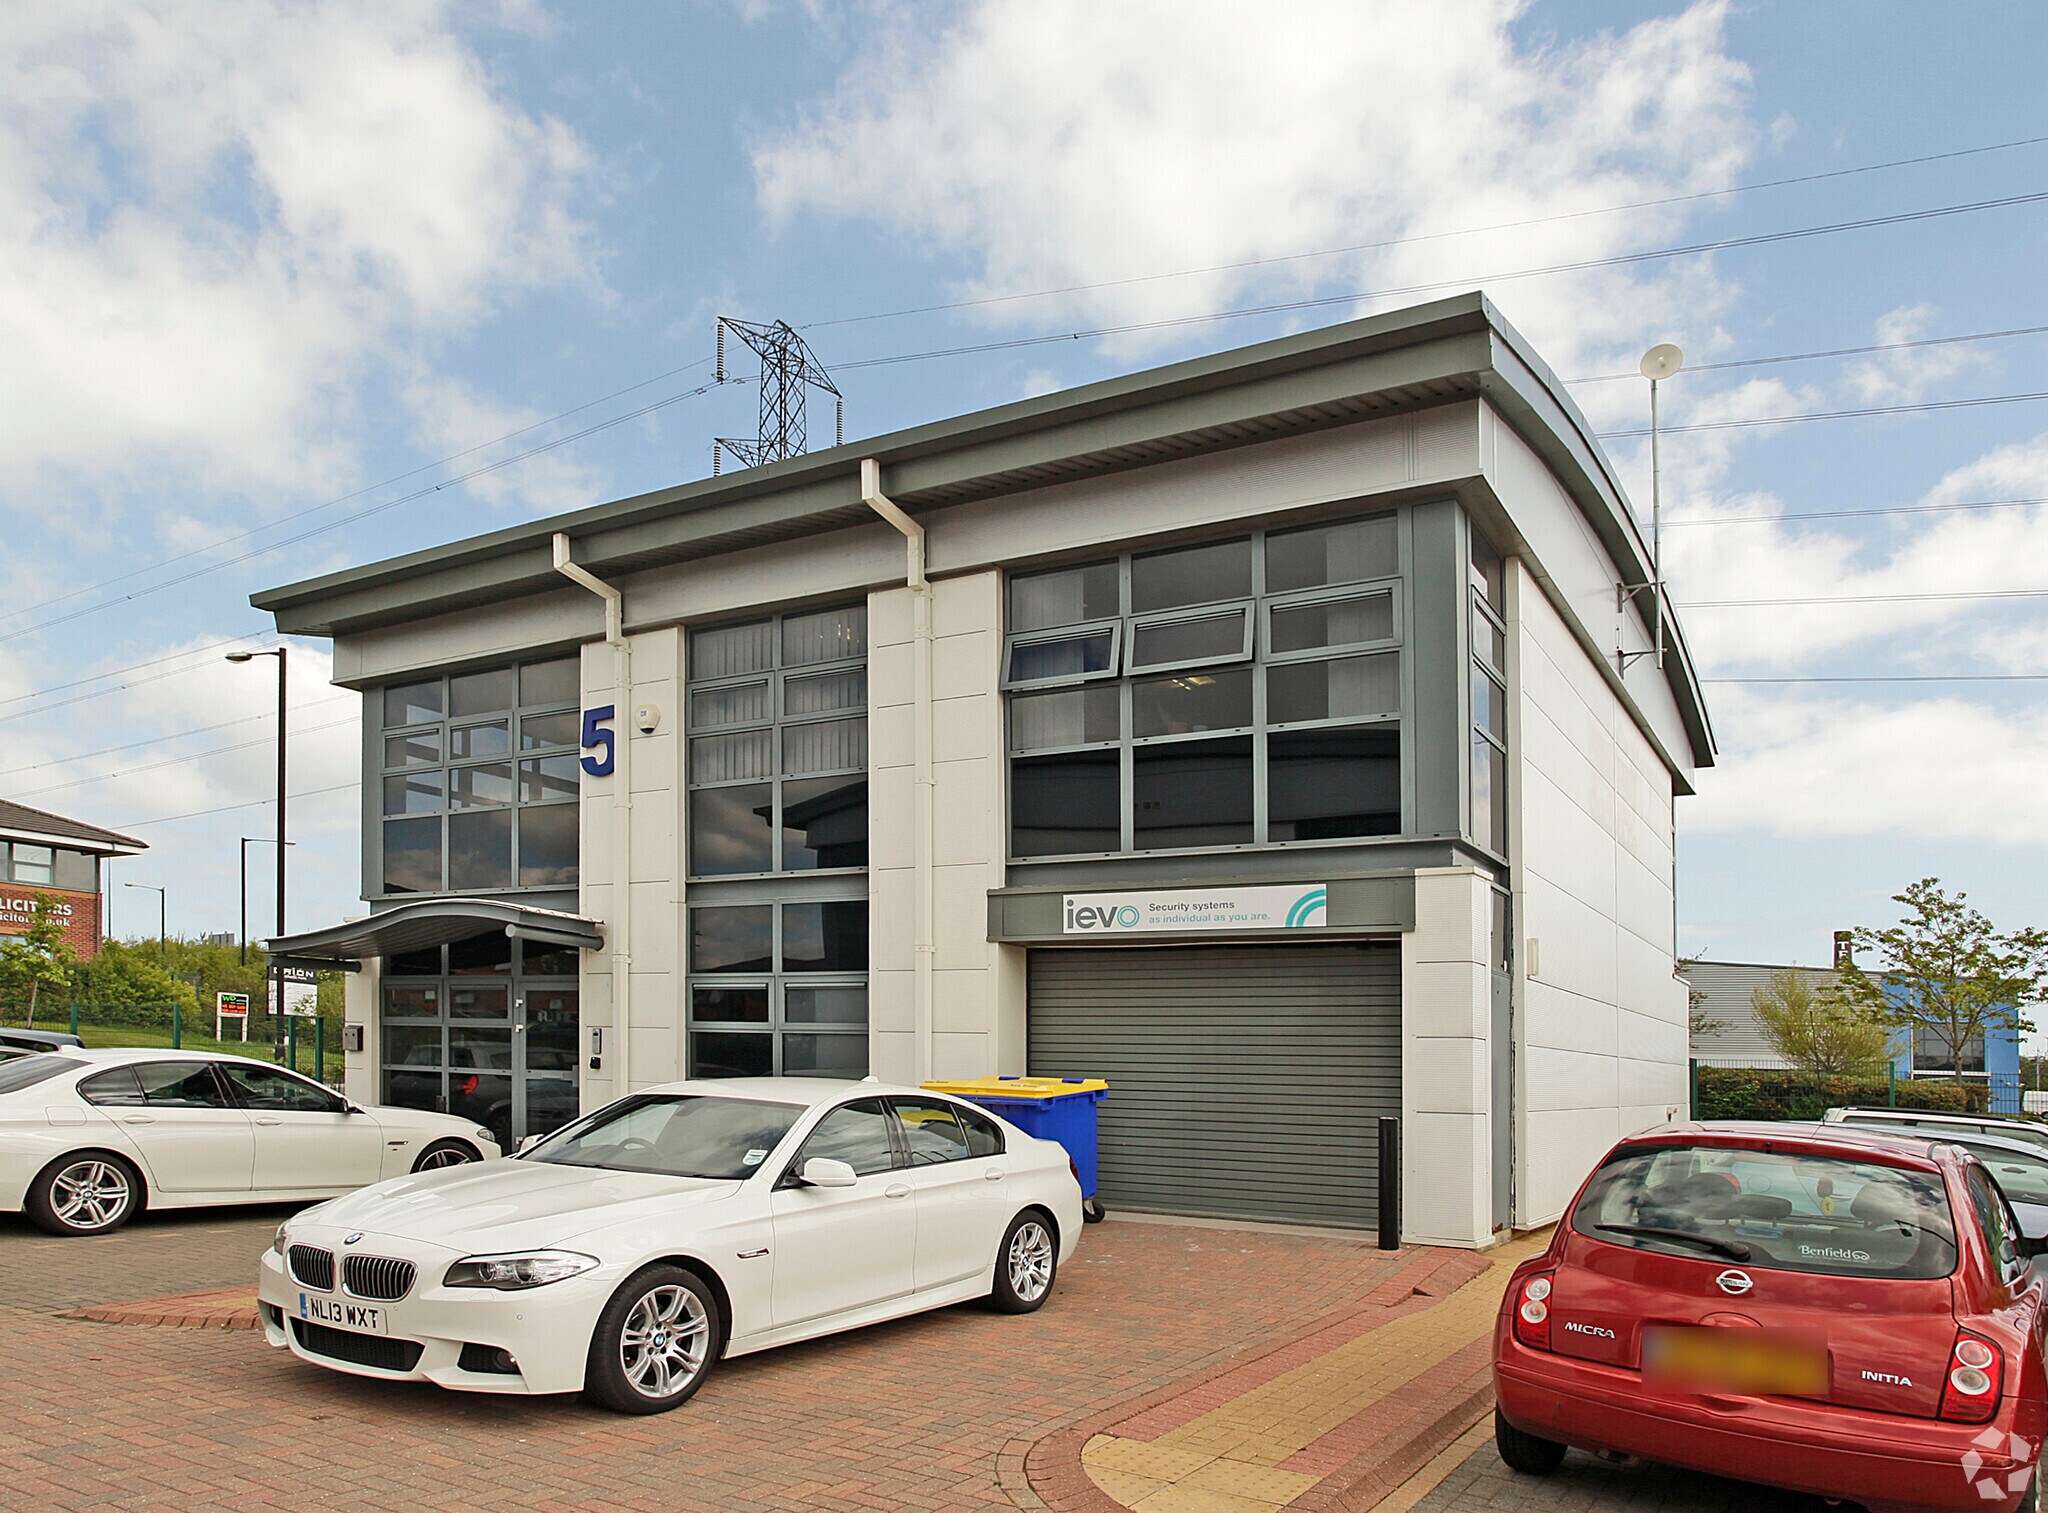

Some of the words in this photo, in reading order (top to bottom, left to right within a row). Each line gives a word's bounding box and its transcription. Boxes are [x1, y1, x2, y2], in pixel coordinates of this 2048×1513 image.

[580, 704, 615, 777] 5
[1066, 899, 1140, 929] ievo
[1148, 902, 1190, 912] Security
[1192, 901, 1235, 911] systems
[1148, 916, 1161, 924] as
[1163, 913, 1211, 923] individual
[1228, 913, 1248, 922] you
[1798, 1245, 1851, 1258] Benfield
[310, 1298, 342, 1323] NL13
[346, 1305, 379, 1328] WXT
[1564, 1321, 1615, 1339] MICRA
[1861, 1370, 1913, 1387] INITIA
